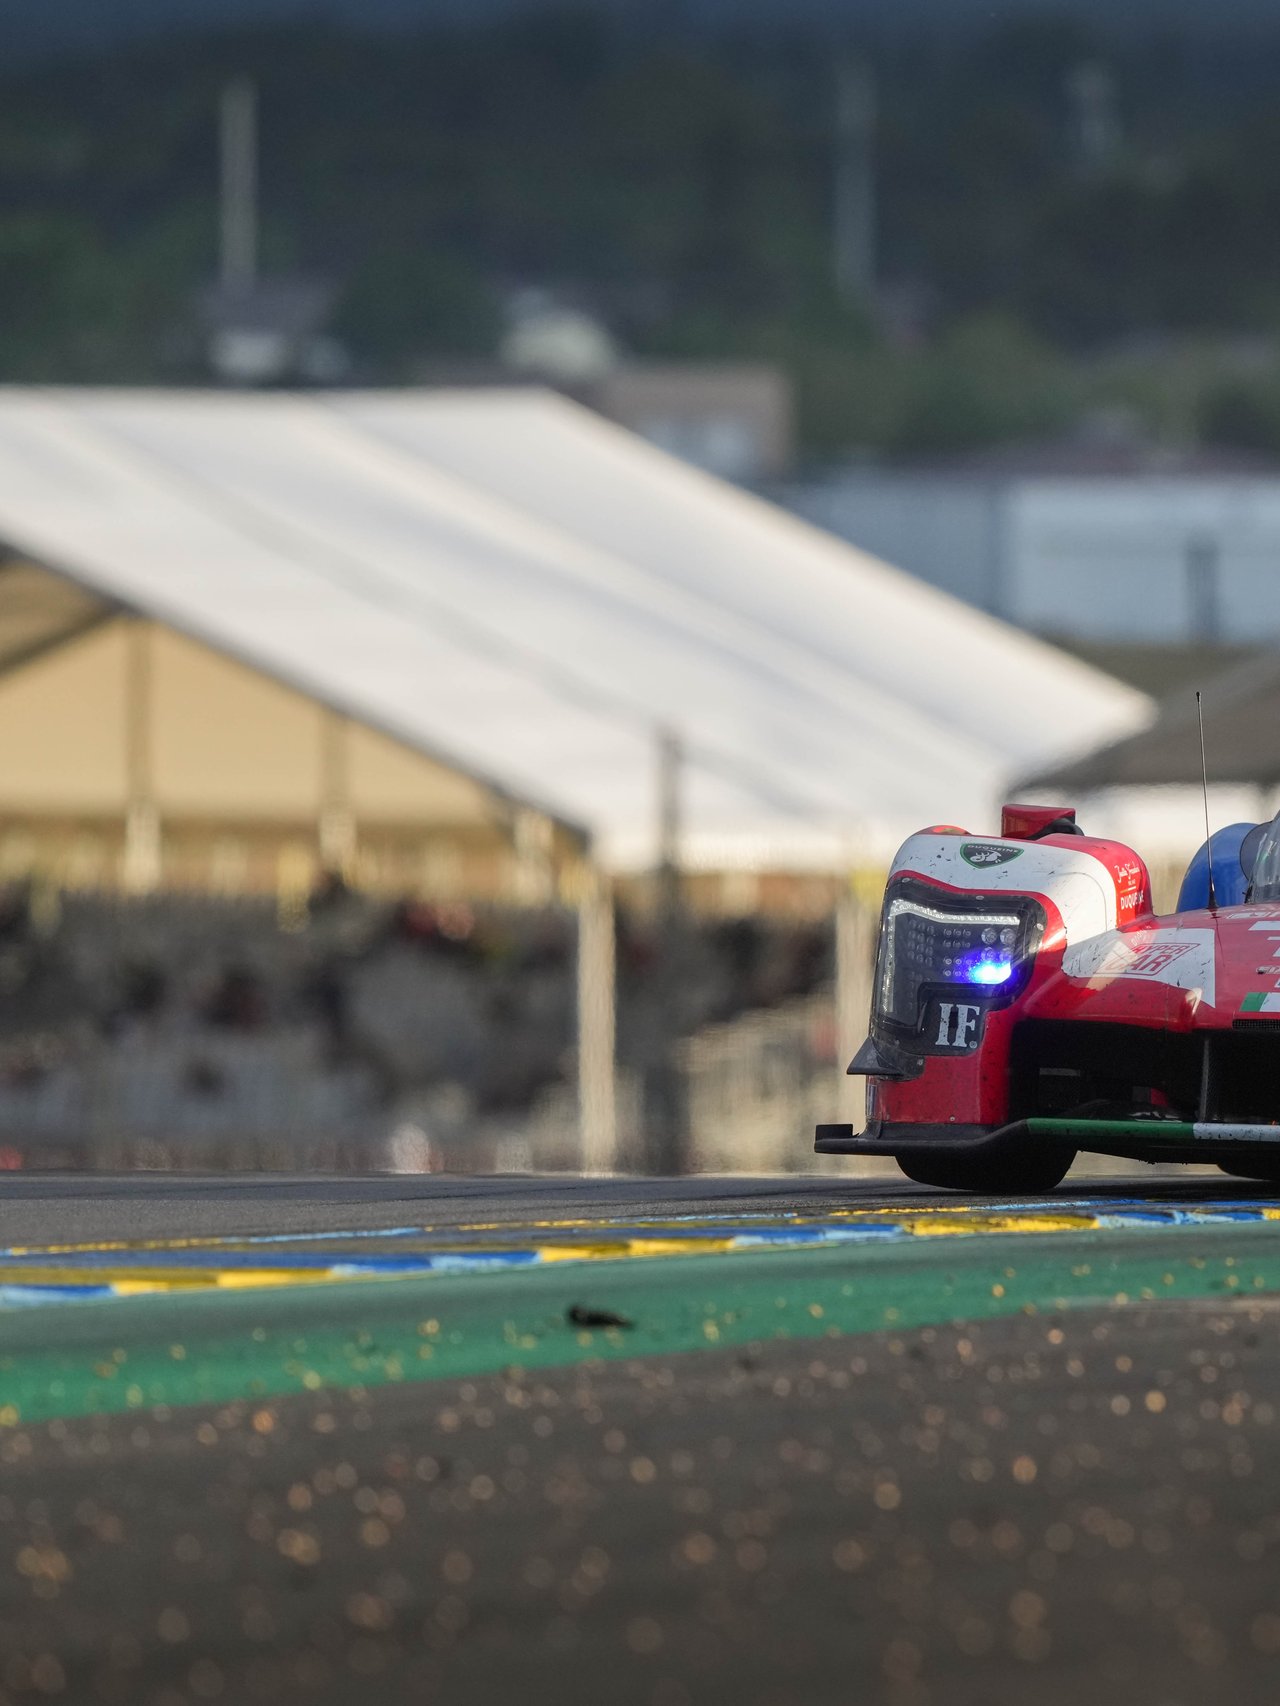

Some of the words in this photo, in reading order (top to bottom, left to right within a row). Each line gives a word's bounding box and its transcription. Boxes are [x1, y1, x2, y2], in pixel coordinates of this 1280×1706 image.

[1131, 945, 1191, 955] HYPER
[1105, 954, 1173, 972] CAR
[935, 1002, 981, 1048] IF
